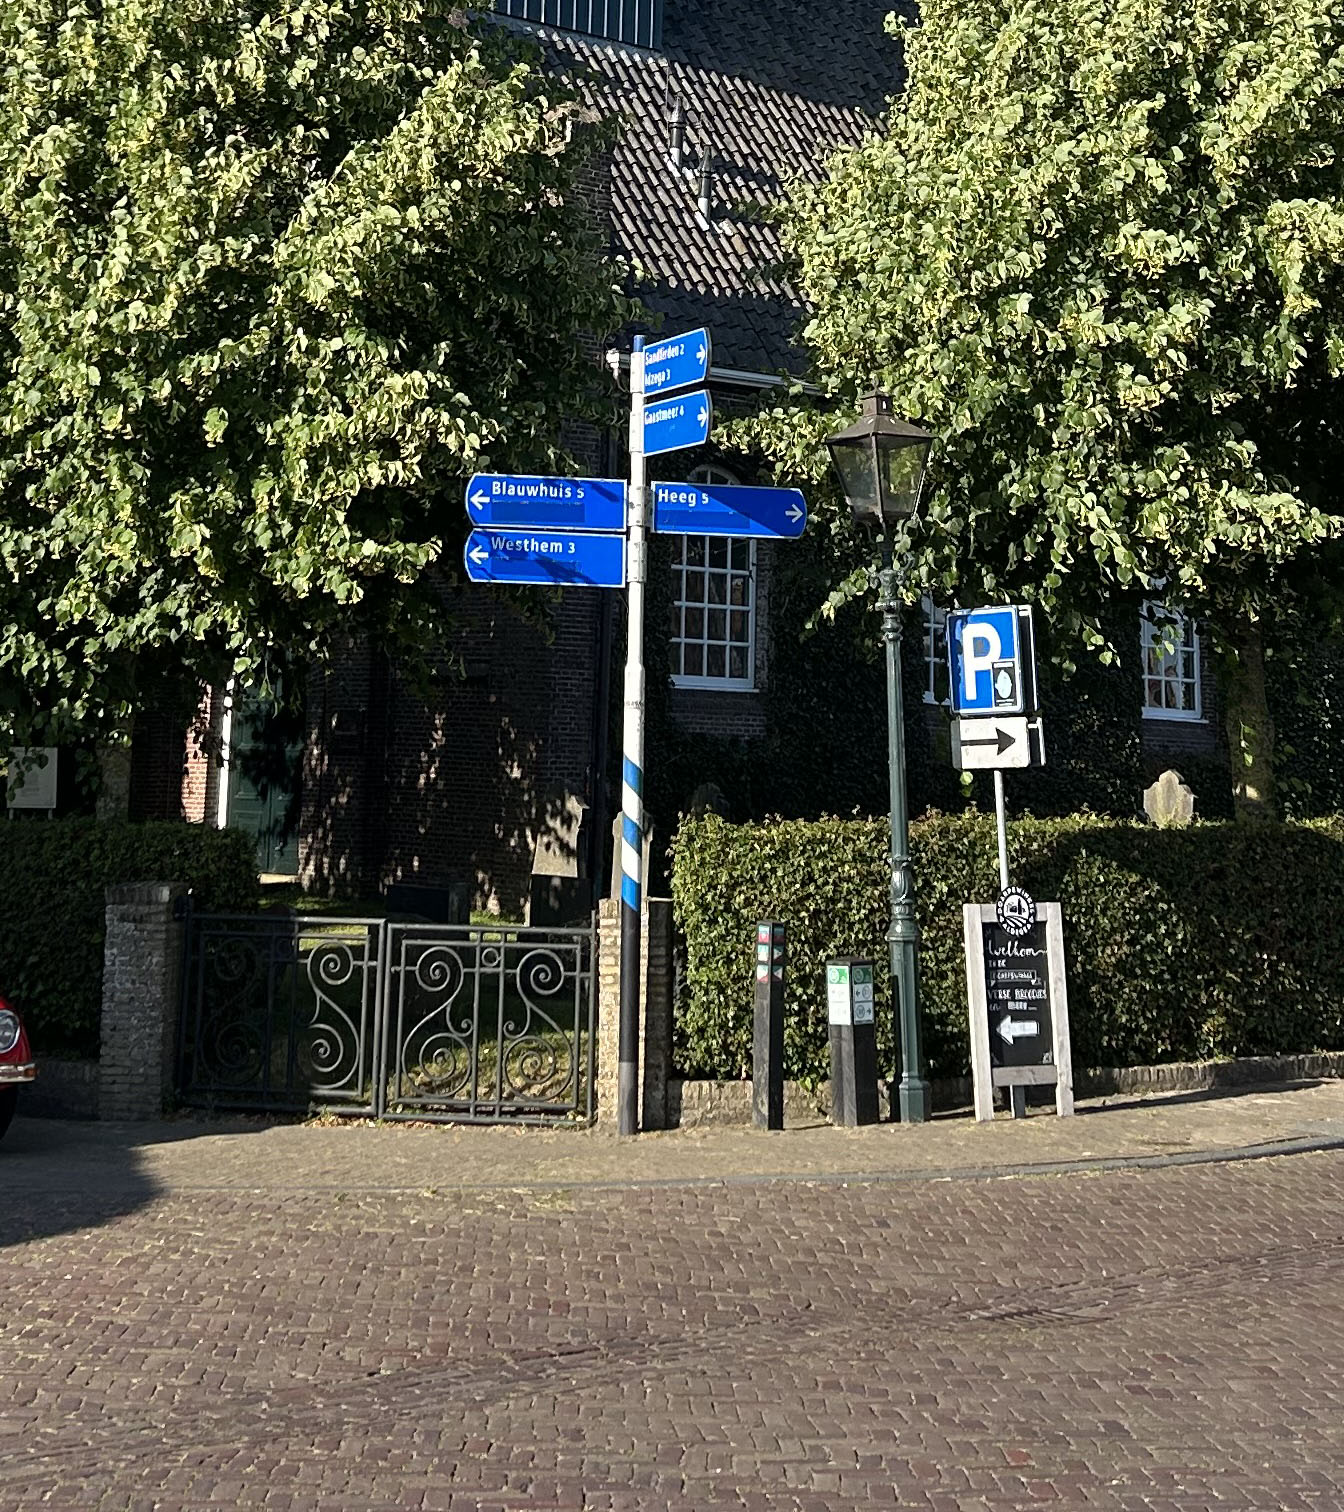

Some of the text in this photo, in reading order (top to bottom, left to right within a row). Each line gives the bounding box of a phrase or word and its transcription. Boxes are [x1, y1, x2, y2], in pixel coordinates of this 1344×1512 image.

[679, 343, 685, 356] 2
[666, 368, 671, 381] 3
[491, 481, 585, 499] Blauwhuis 5
[658, 490, 709, 507] Heeg 5
[491, 536, 576, 554] Westhem 3
[962, 622, 1002, 701] P
